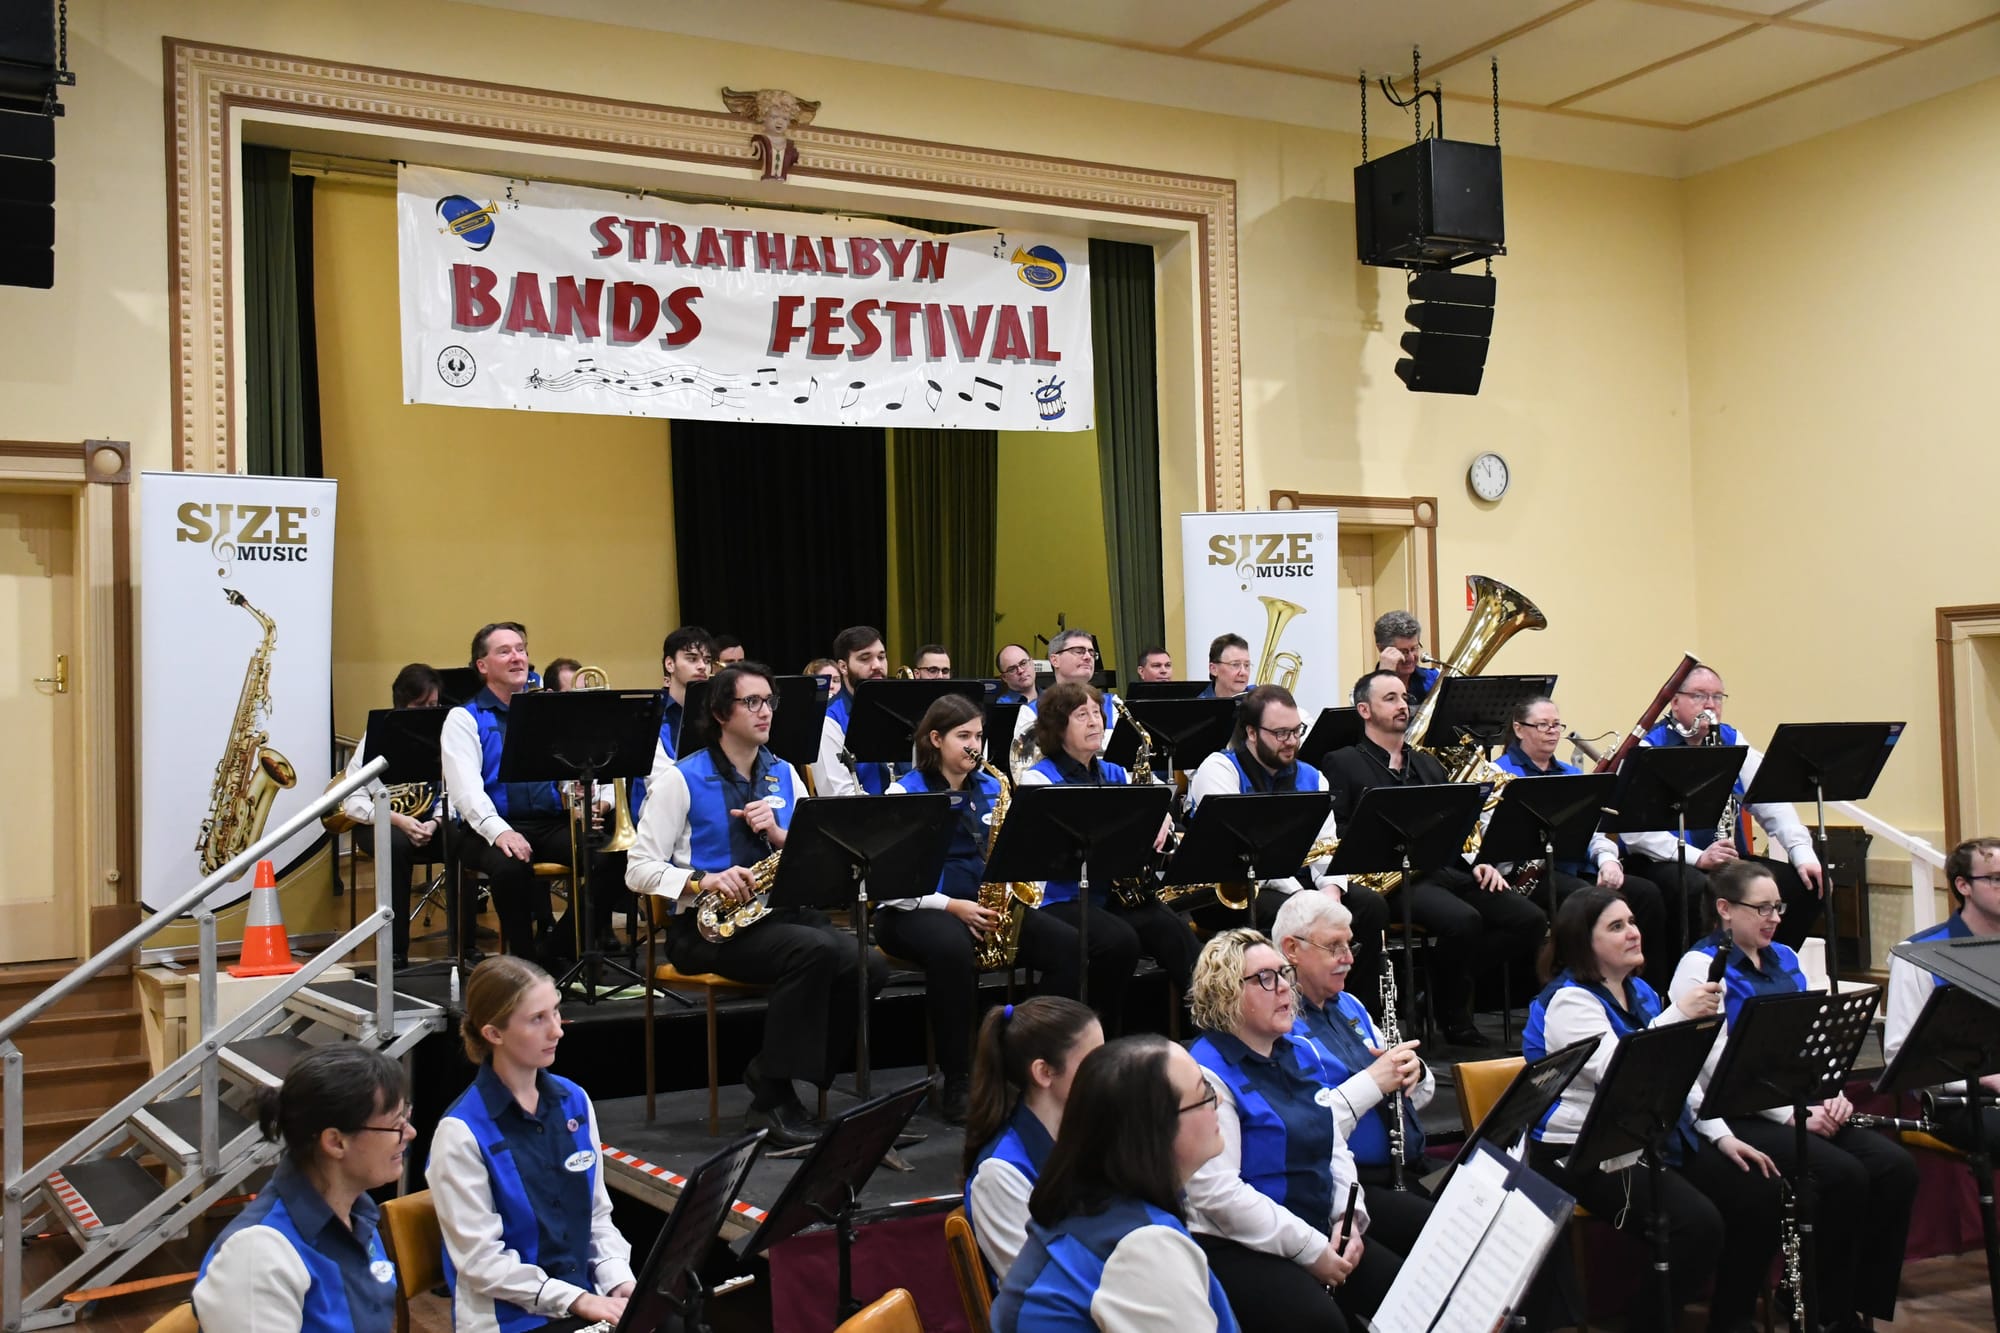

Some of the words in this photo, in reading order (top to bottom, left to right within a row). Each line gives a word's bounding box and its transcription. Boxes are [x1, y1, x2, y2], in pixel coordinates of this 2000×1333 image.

[593, 216, 950, 284] STRATHALBYN
[450, 263, 704, 351] BANDS
[767, 295, 1062, 366] FESTIVAL
[177, 502, 307, 549] SIZE
[237, 546, 307, 562] MUSIC
[1208, 533, 1313, 570] SIZE
[1256, 565, 1314, 578] MUSIC
